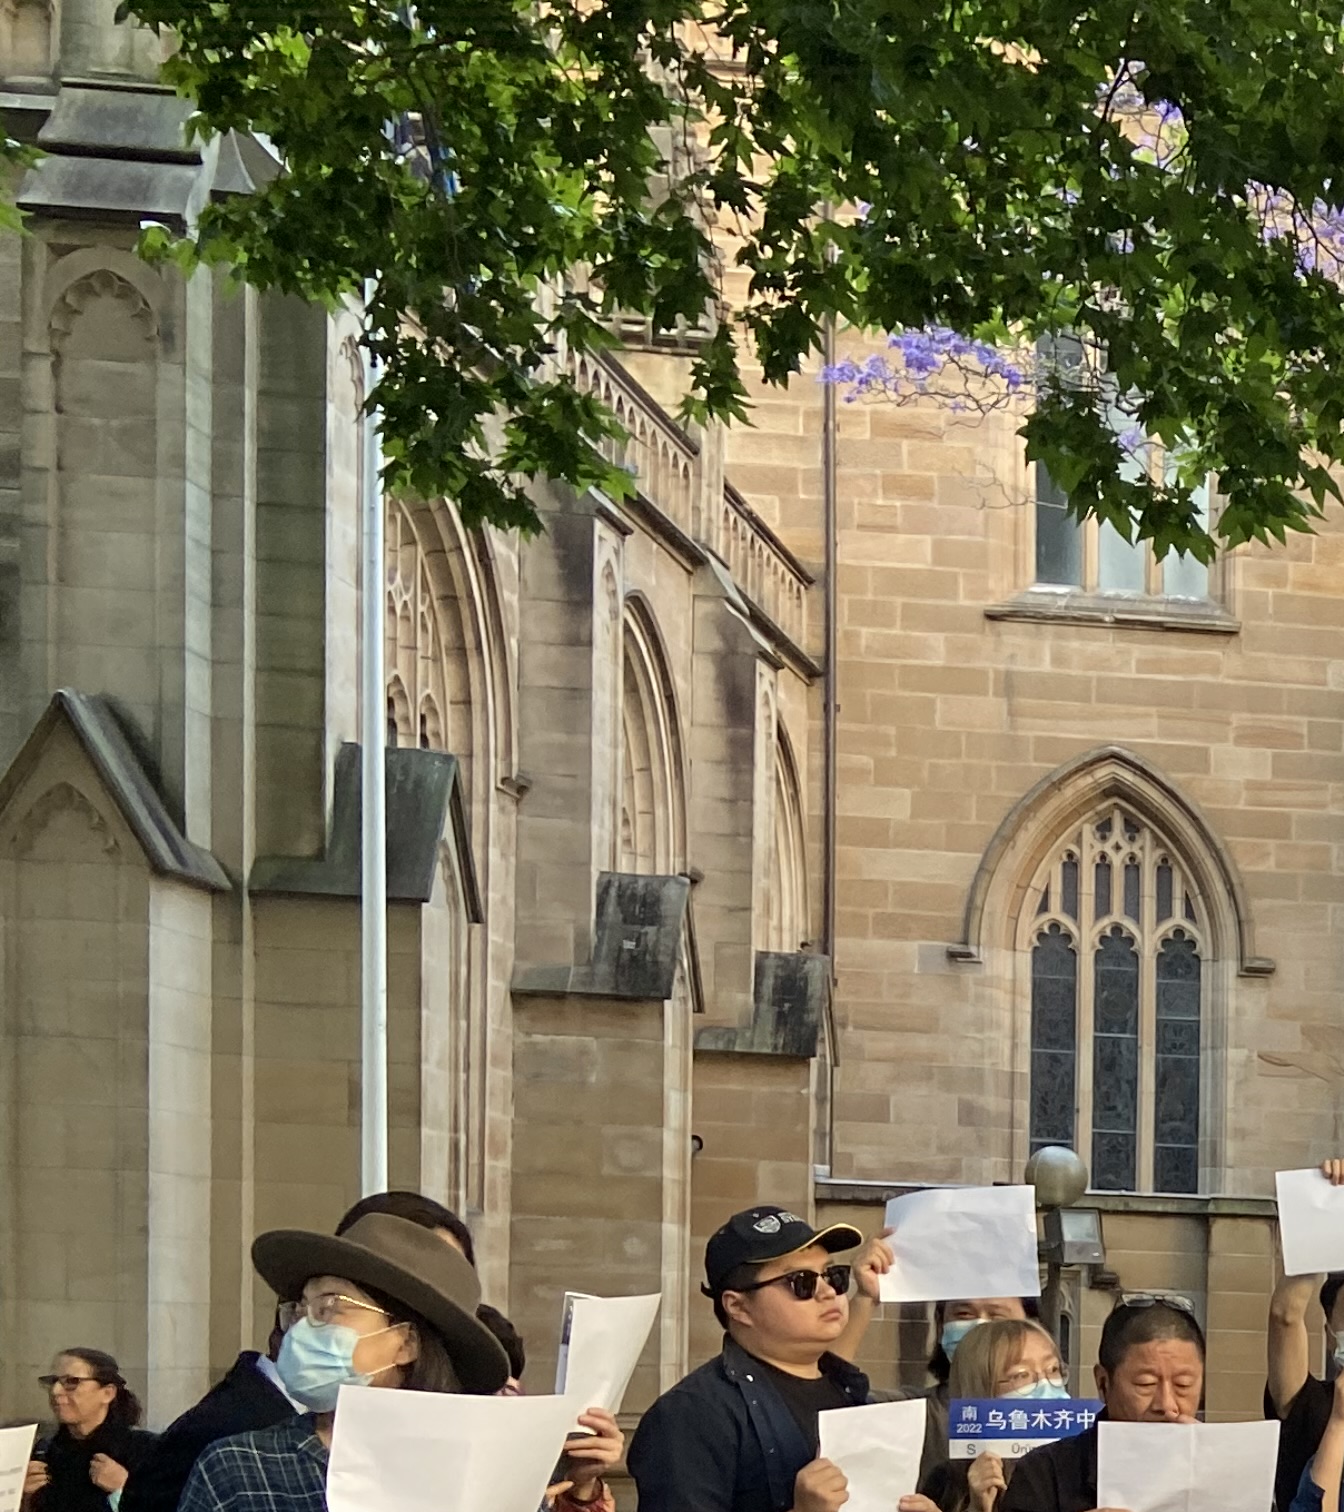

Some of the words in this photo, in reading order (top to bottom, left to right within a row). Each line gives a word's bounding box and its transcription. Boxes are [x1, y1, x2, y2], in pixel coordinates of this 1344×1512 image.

[962, 1406, 977, 1421] 南
[957, 1423, 982, 1433] 2022
[967, 1444, 976, 1455] S
